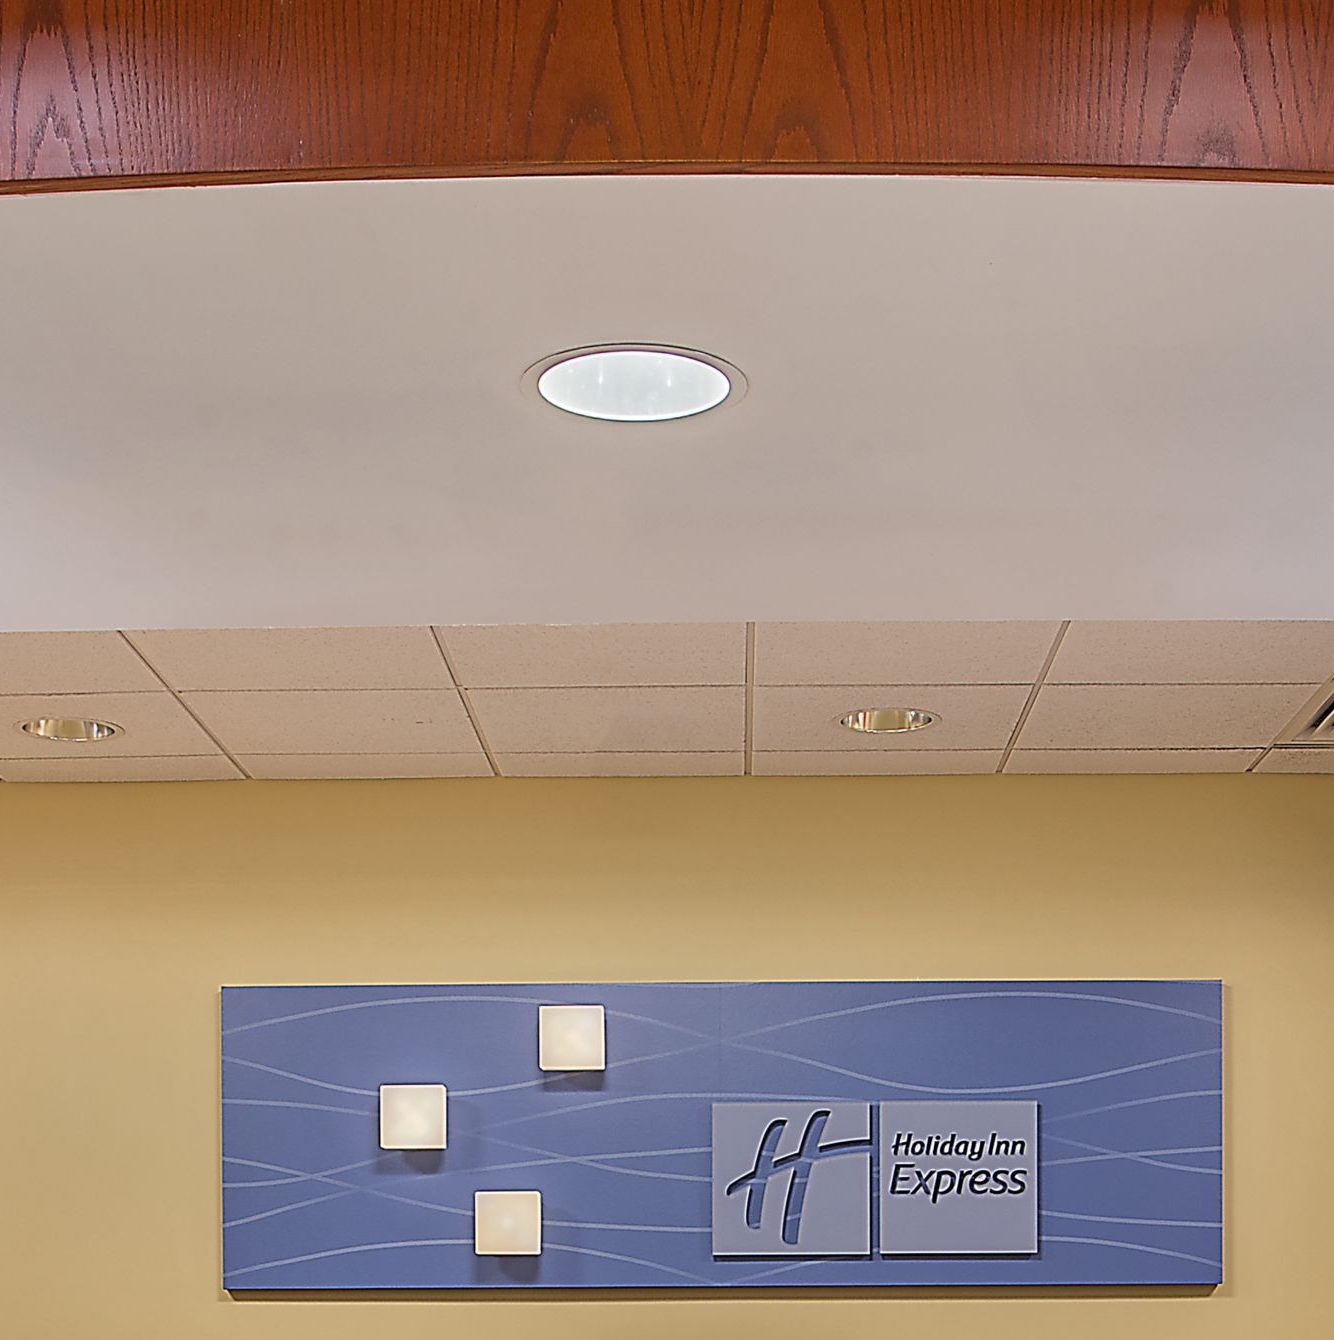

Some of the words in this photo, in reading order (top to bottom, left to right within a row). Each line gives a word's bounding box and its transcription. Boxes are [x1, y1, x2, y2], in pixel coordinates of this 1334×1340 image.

[891, 1132, 986, 1161] Holiday
[988, 1132, 1026, 1156] Inn
[889, 1163, 1027, 1204] Express
